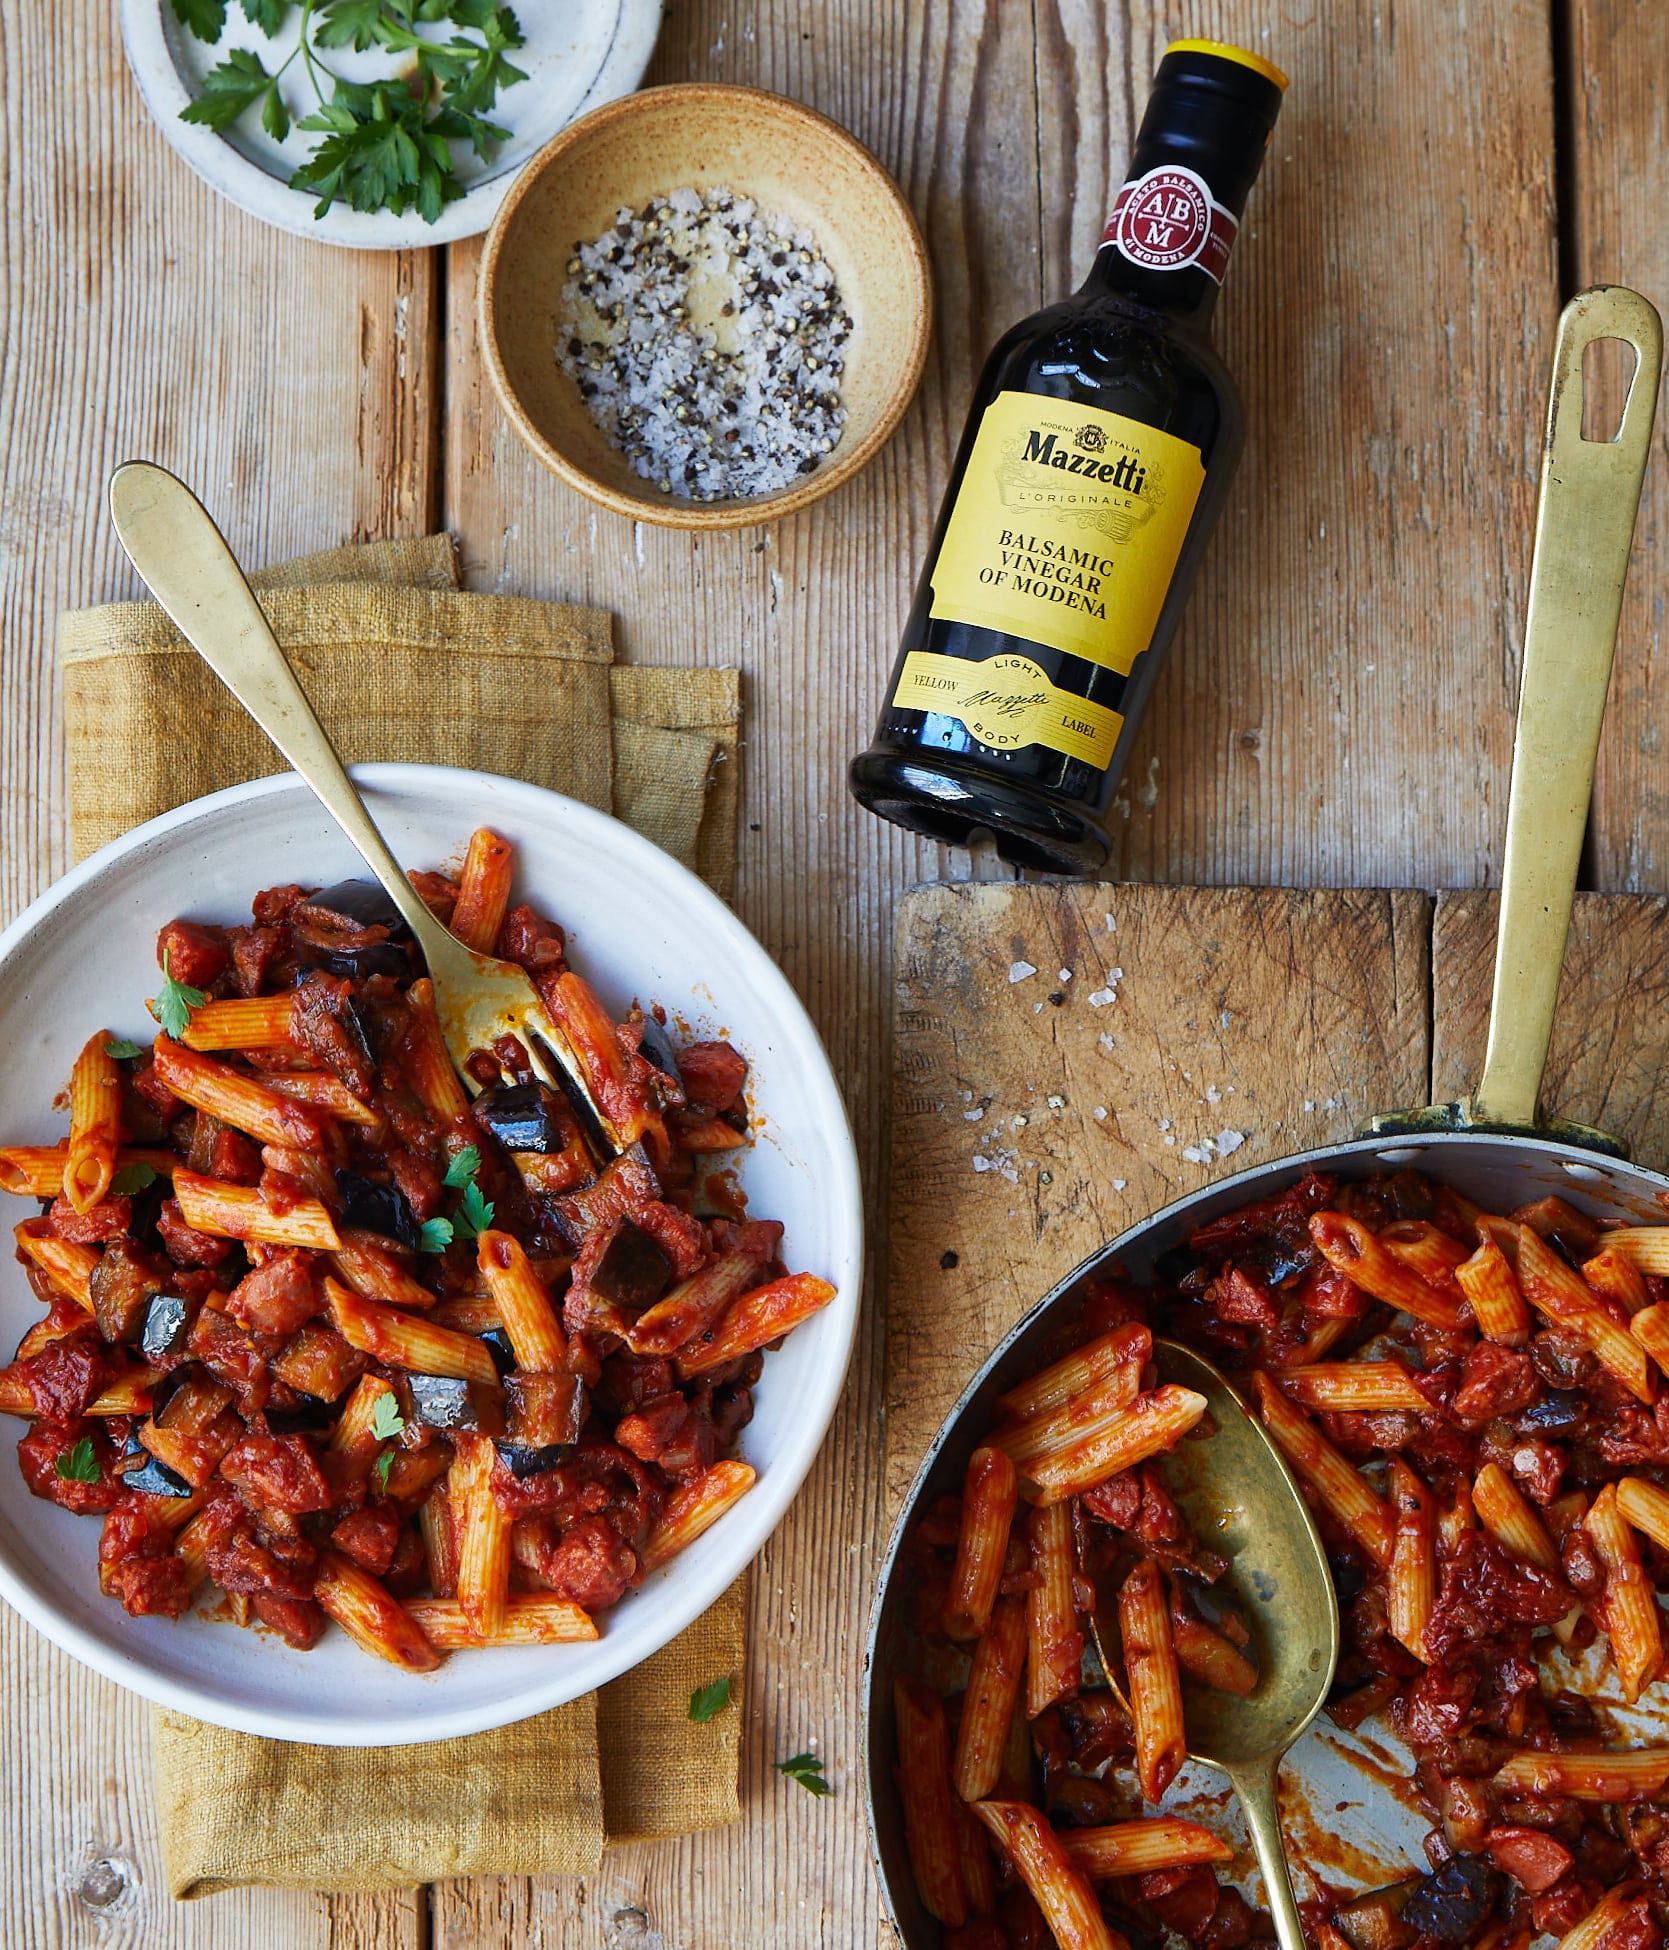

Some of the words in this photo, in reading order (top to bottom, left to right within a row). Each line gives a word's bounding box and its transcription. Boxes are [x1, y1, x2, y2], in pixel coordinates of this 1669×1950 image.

[1129, 180, 1158, 214] ACETO
[1163, 176, 1205, 232] BALSAMICO
[1133, 247, 1185, 264] MODENA
[1040, 421, 1074, 433] MODENA
[1110, 439, 1140, 454] ITALIA
[1021, 430, 1147, 495] Mazzetti
[1019, 492, 1132, 509] L'ORIGINALE
[999, 529, 1114, 577] BALSAMIC
[1001, 550, 1102, 595] VINEGAR
[979, 567, 1008, 586] OF
[1011, 574, 1106, 620] MODENA
[913, 674, 959, 692] YELLOW
[994, 659, 1042, 680] LIGHT
[973, 722, 1020, 744] BODY
[1061, 715, 1097, 739] LABEL
